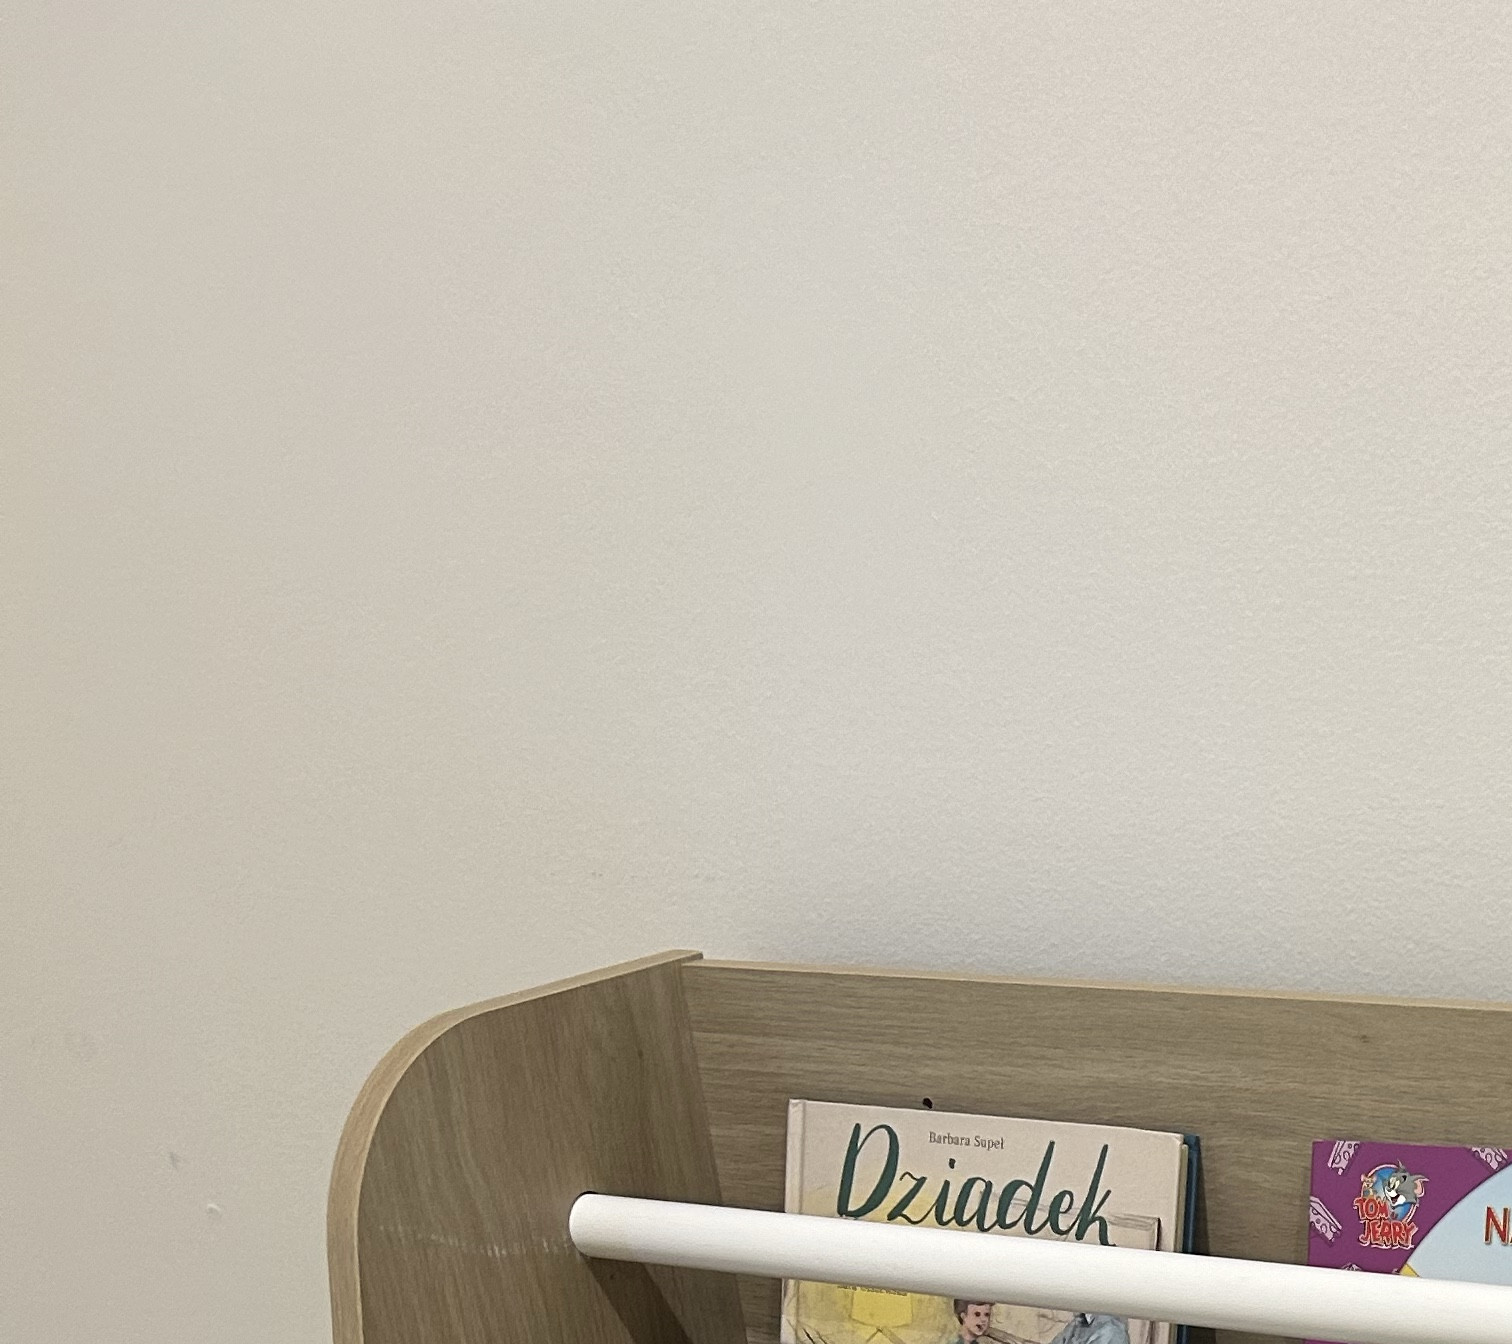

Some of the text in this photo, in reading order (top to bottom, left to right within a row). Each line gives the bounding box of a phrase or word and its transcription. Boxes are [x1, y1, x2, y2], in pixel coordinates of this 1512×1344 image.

[928, 1130, 971, 1148] Barbara
[836, 1122, 1116, 1247] Dziadek
[1353, 1196, 1389, 1220] TOM
[1359, 1219, 1418, 1249] JERRY
